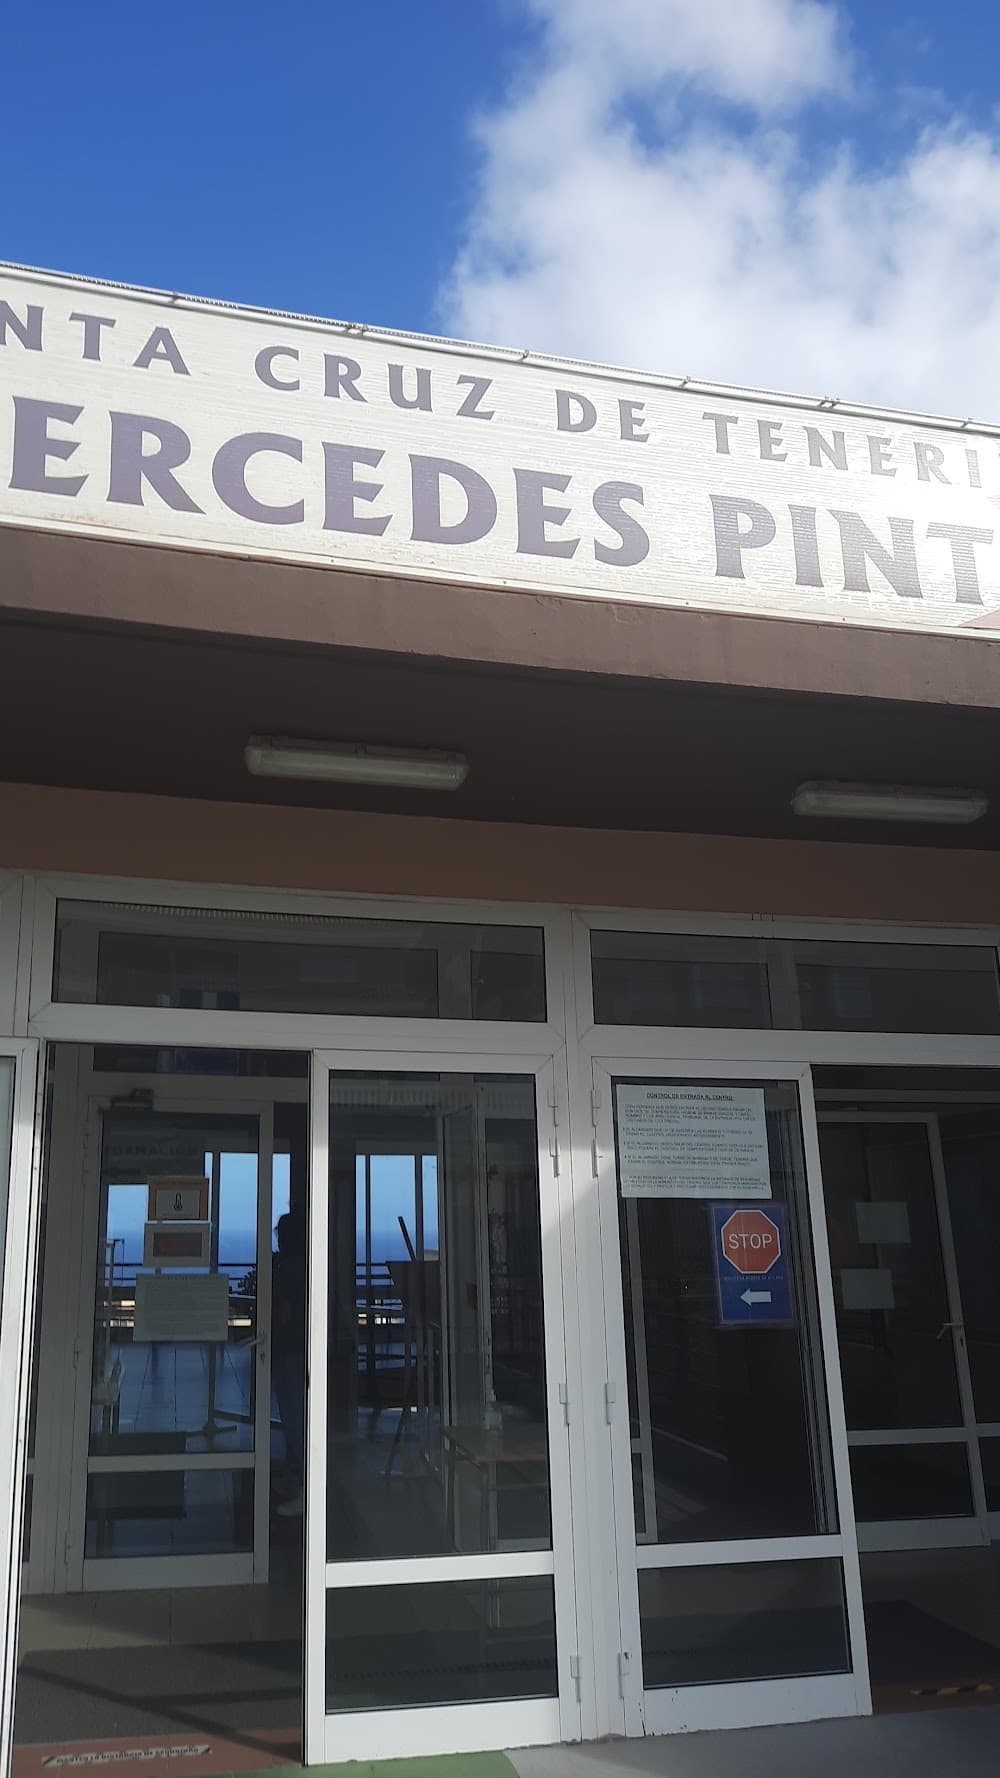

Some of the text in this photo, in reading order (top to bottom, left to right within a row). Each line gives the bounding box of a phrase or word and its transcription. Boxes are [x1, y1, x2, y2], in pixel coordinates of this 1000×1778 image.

[0, 304, 191, 376] NTA
[254, 345, 496, 420] CRUZ
[555, 389, 650, 443] DE
[8, 395, 994, 606] ERCEDES PINT
[728, 1233, 772, 1249] STOP
